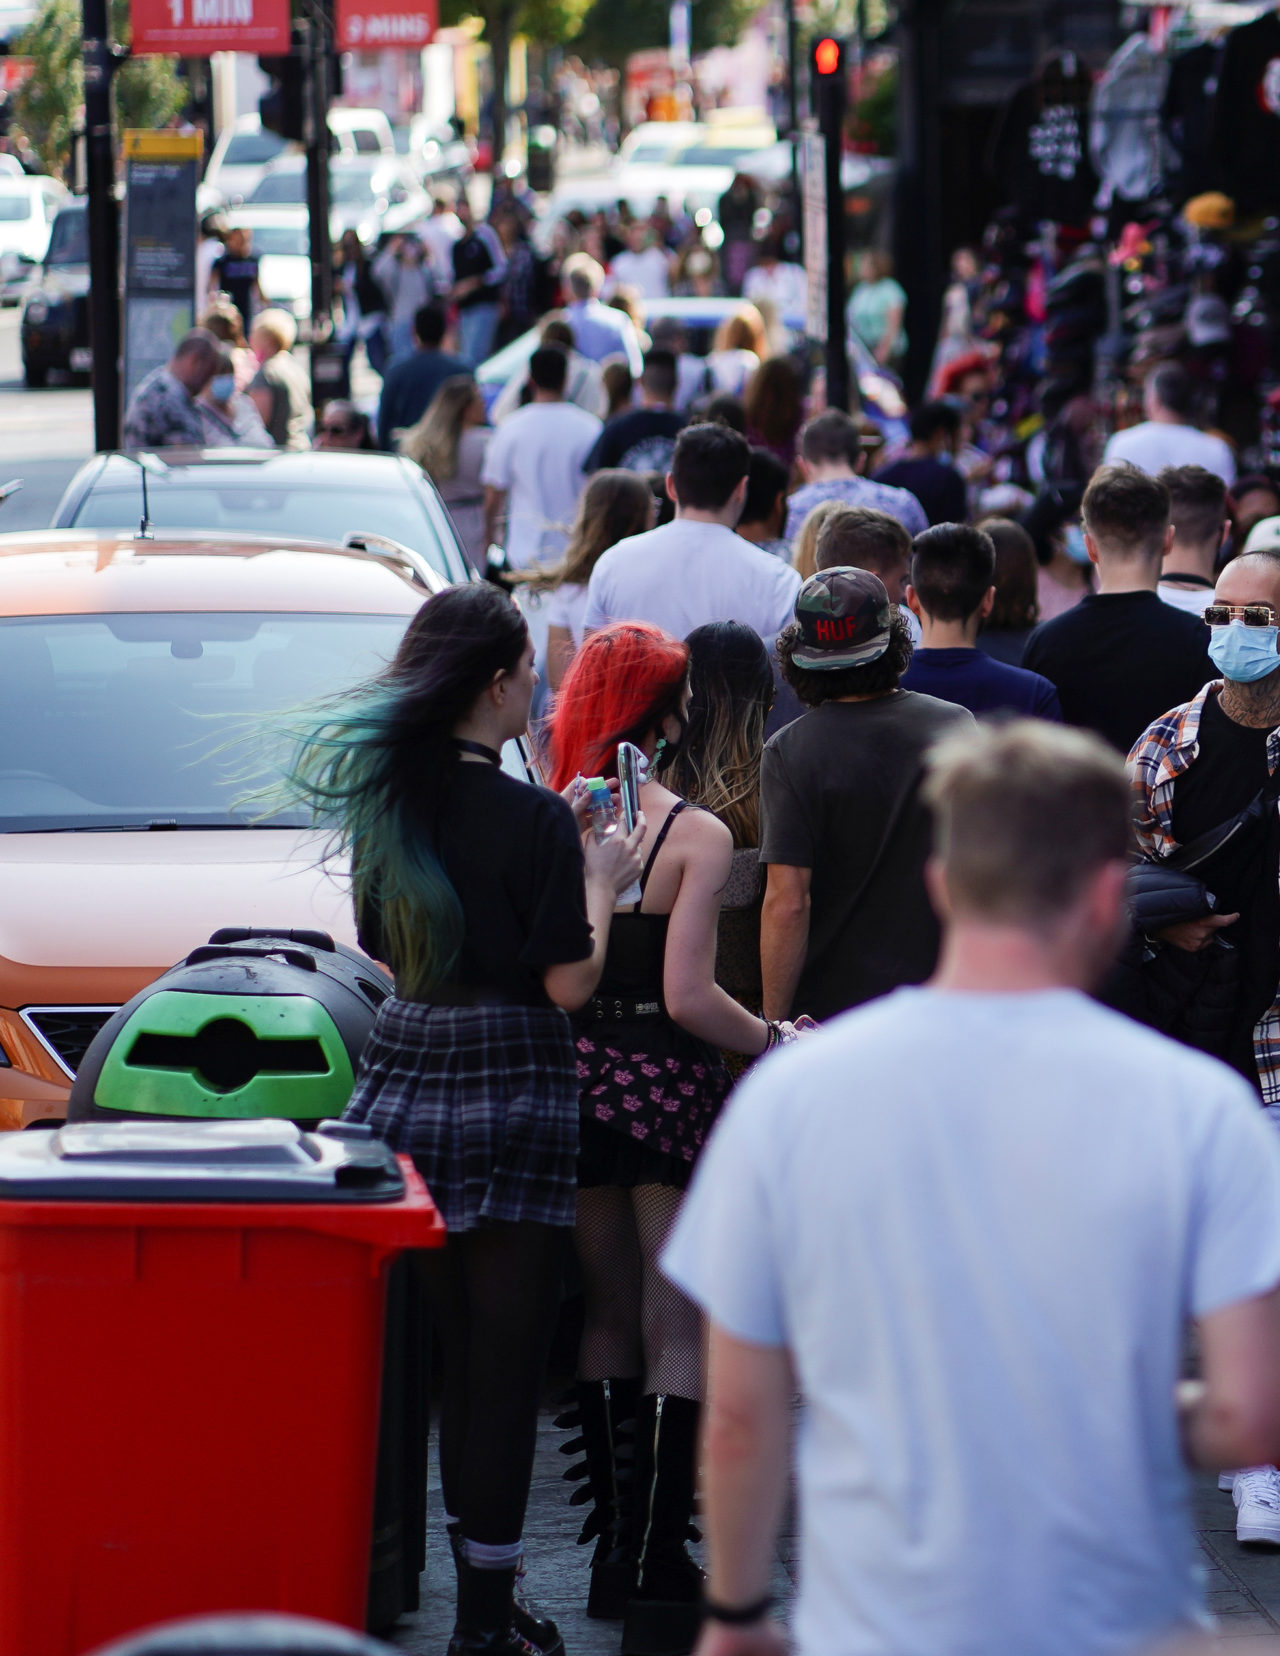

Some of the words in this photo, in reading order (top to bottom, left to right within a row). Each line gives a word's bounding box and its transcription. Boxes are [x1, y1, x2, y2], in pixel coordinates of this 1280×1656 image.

[192, 0, 253, 27] MIN
[365, 12, 430, 43] MINS
[816, 615, 857, 641] HUF
